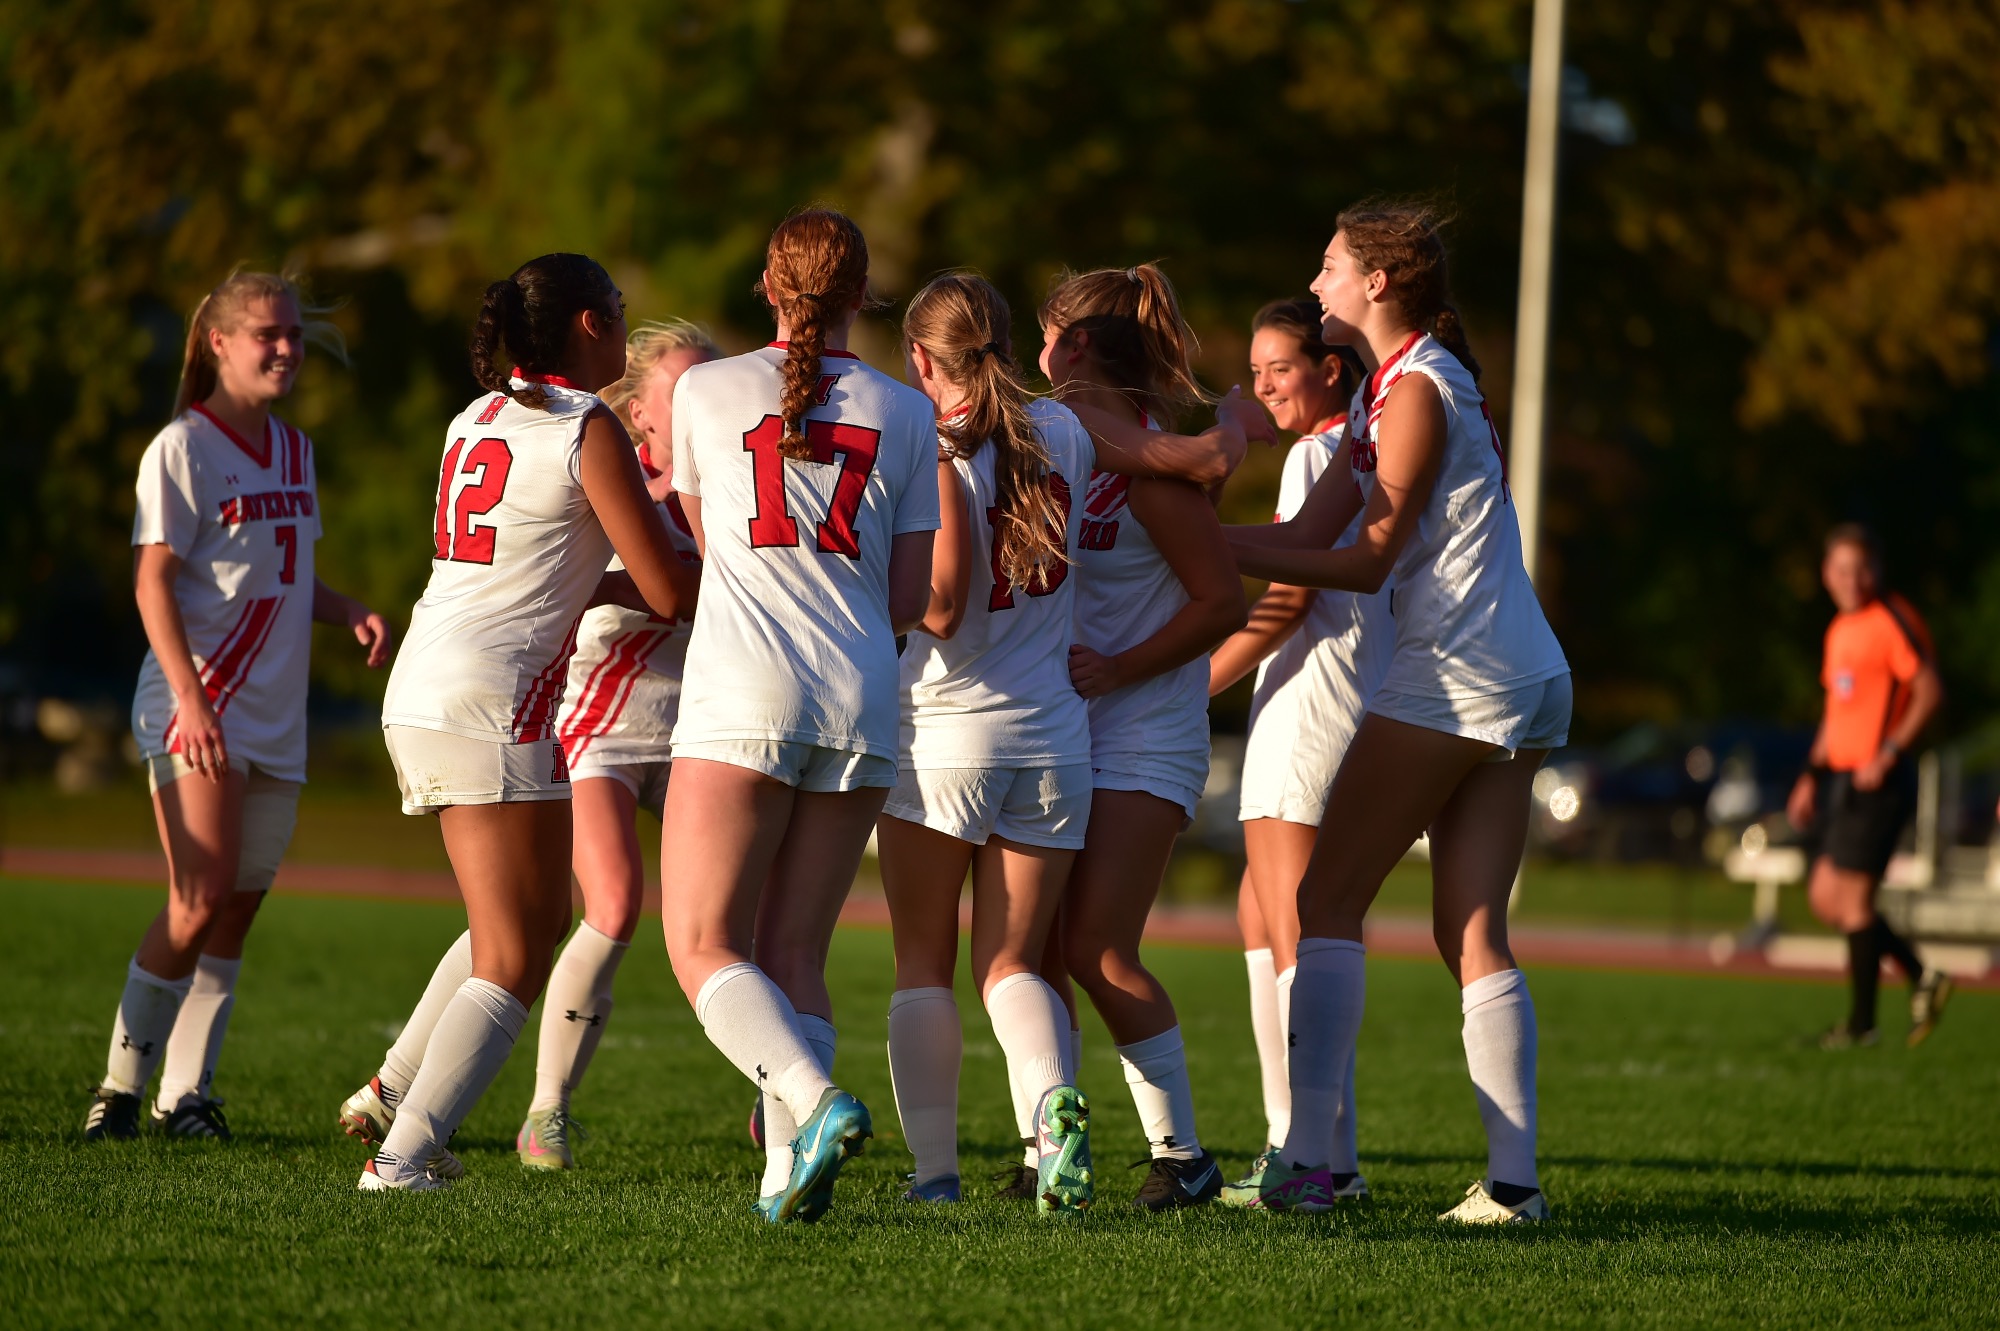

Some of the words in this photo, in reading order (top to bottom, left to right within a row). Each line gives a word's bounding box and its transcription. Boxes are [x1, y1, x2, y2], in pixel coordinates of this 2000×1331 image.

[434, 437, 514, 565] 12
[742, 413, 882, 561] 17
[275, 525, 297, 585] 7
[1077, 518, 1120, 551] RD
